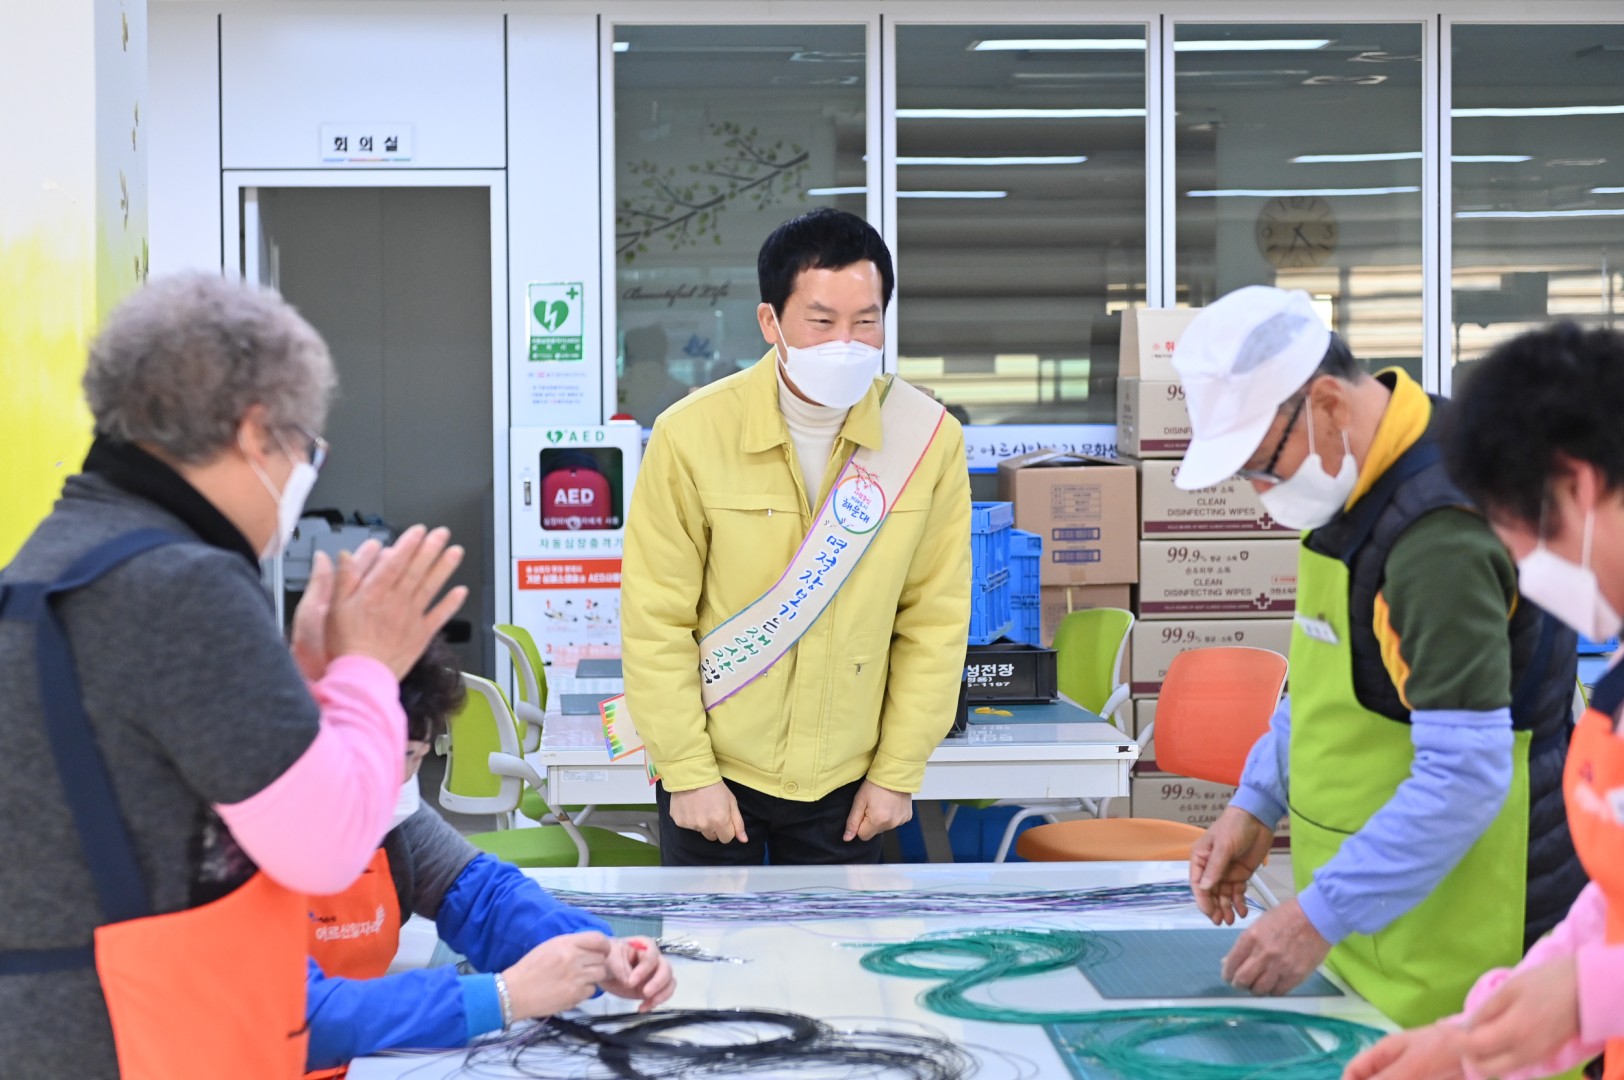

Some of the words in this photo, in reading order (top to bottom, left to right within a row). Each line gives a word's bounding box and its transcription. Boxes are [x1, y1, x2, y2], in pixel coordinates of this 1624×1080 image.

[334, 135, 398, 152] 회의실
[569, 431, 605, 442] AED
[554, 488, 595, 505] AED
[1197, 498, 1226, 507] CLEAN
[842, 498, 870, 523] 해운대
[1167, 508, 1226, 517] DISINFECTING
[1229, 507, 1255, 516] WIPES
[1193, 578, 1223, 587] CLEAN
[1164, 588, 1222, 598] DISINFECTING
[1225, 587, 1252, 596] WIPES
[967, 663, 1014, 677] 성전장
[1187, 816, 1216, 824] CLEAN
